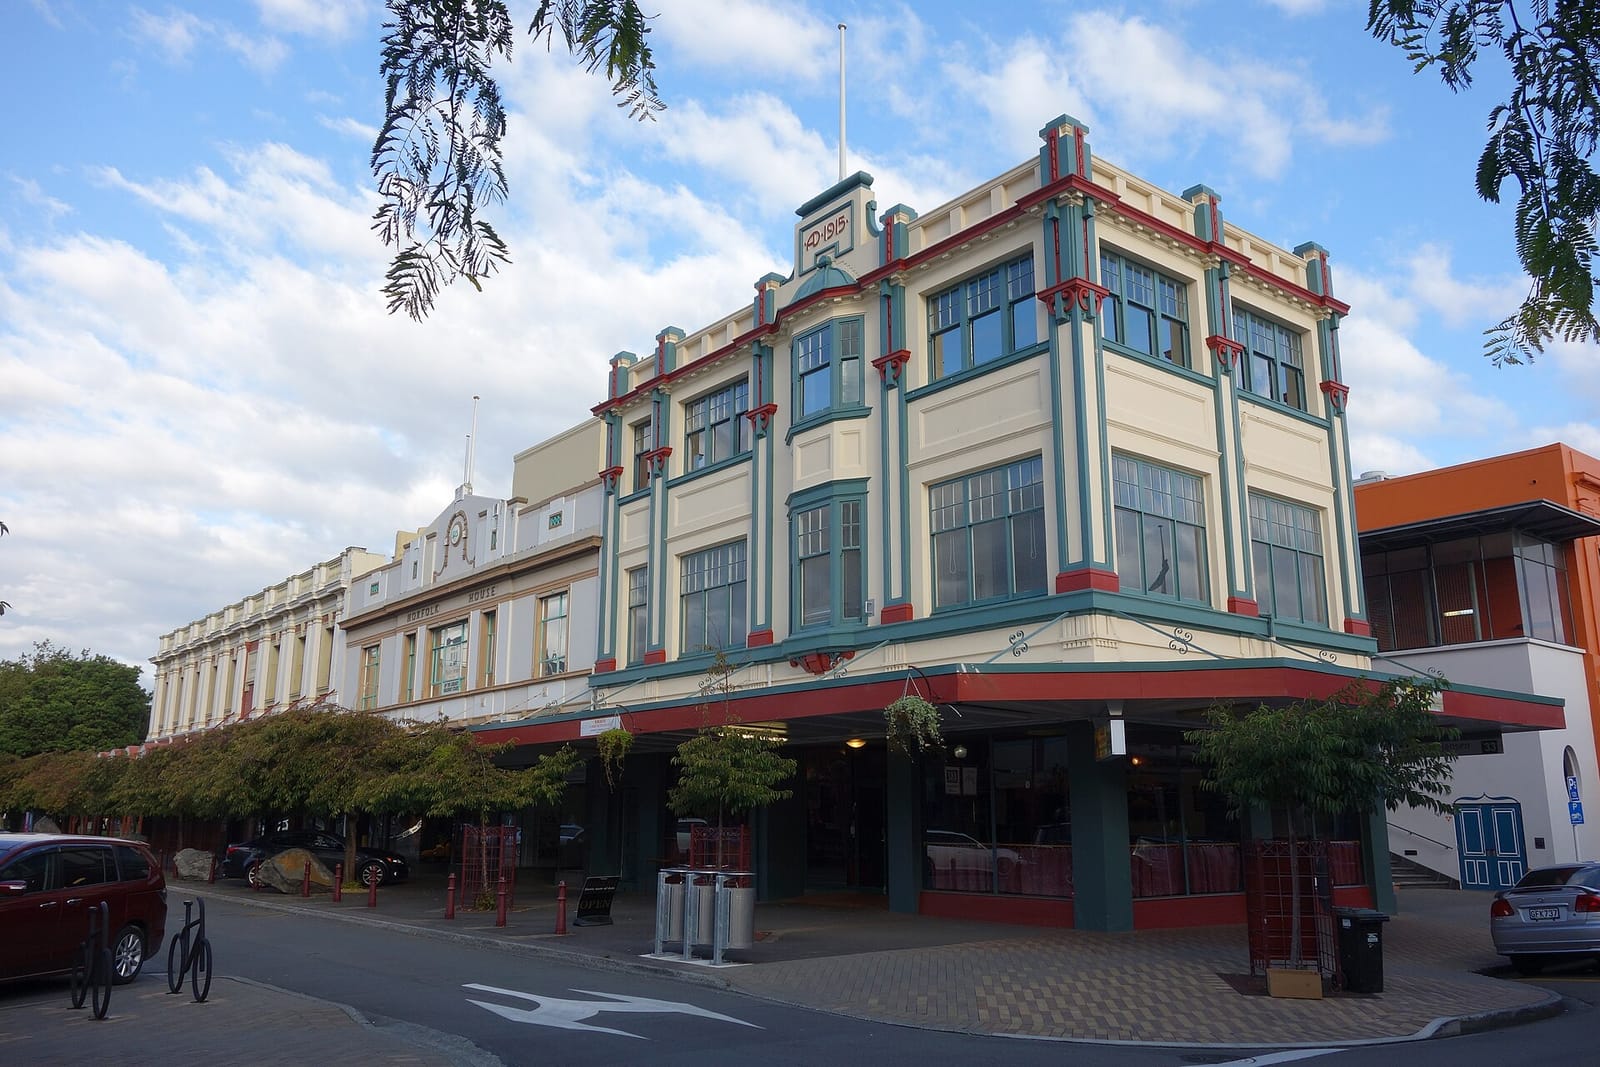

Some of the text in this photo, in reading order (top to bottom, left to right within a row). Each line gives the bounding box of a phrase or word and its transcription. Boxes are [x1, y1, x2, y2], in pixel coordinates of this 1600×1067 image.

[407, 587, 496, 623] NORFOLK HOUSE
[580, 899, 610, 909] OPEN
